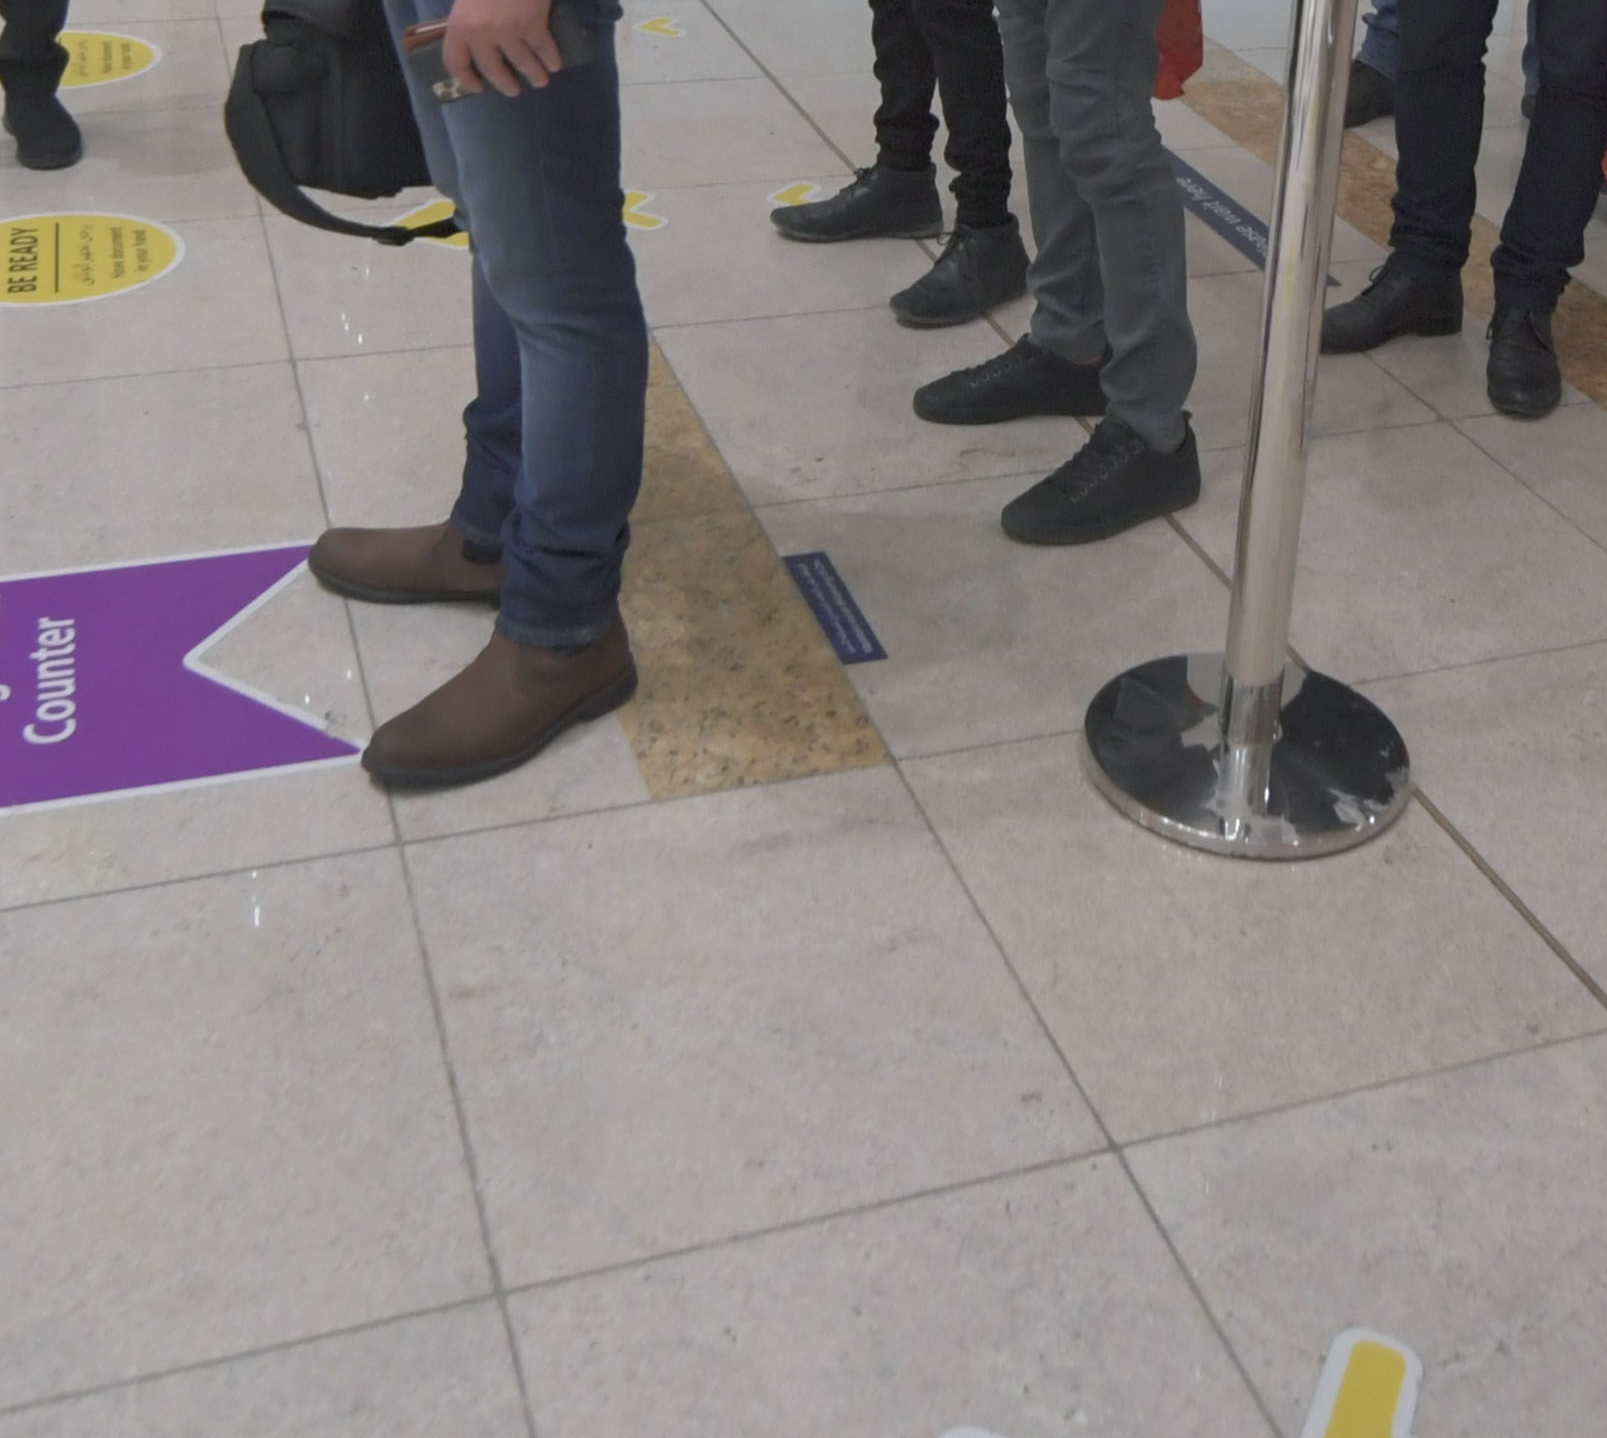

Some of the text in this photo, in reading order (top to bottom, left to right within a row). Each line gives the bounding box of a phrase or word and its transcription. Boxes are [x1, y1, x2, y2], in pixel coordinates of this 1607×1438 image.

[1176, 177, 1213, 201] here
[1203, 200, 1241, 224] wait
[7, 227, 39, 294] BE READY
[22, 617, 77, 745] Counter
